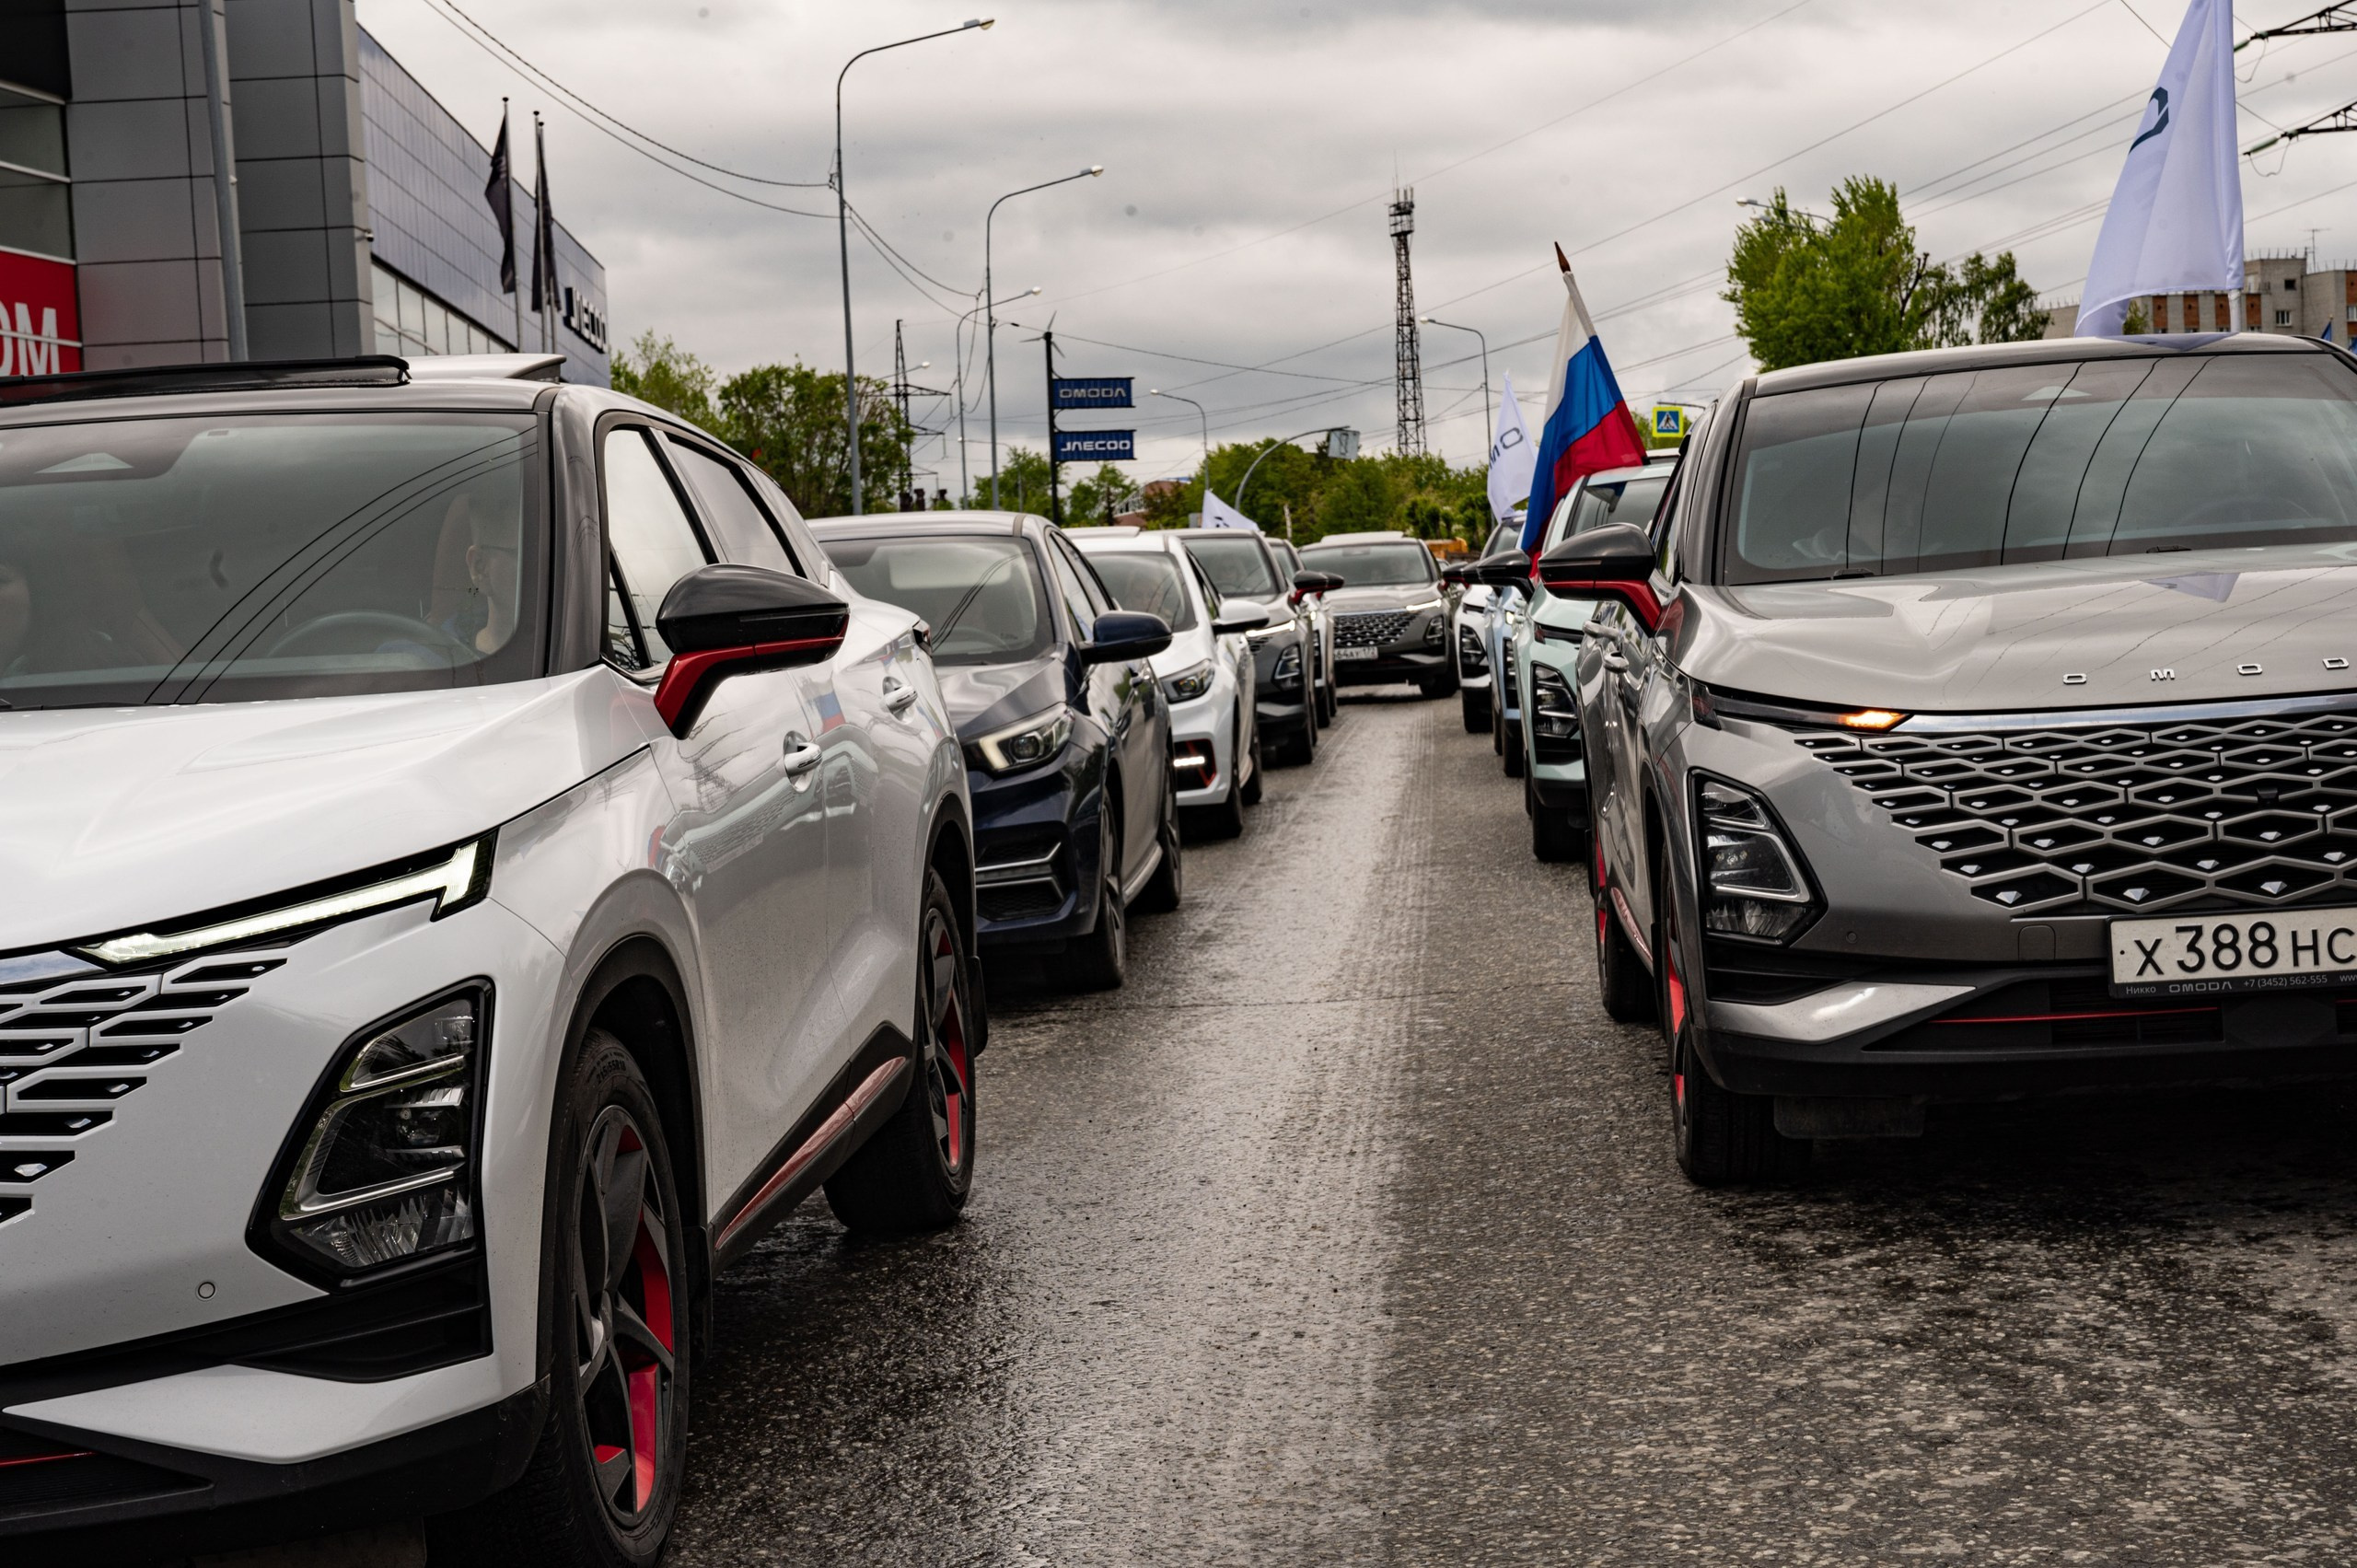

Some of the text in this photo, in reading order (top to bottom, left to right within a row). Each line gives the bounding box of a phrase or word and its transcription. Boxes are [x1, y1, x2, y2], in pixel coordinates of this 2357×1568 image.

[1059, 388, 1127, 399] OMODA
[1061, 440, 1132, 451] JAECOO
[2126, 985, 2157, 995] Никко
[2169, 981, 2232, 993] OMODA
[2244, 979, 2255, 988] +7
[2258, 977, 2288, 989] (3452)
[2289, 974, 2328, 986] 562-555
